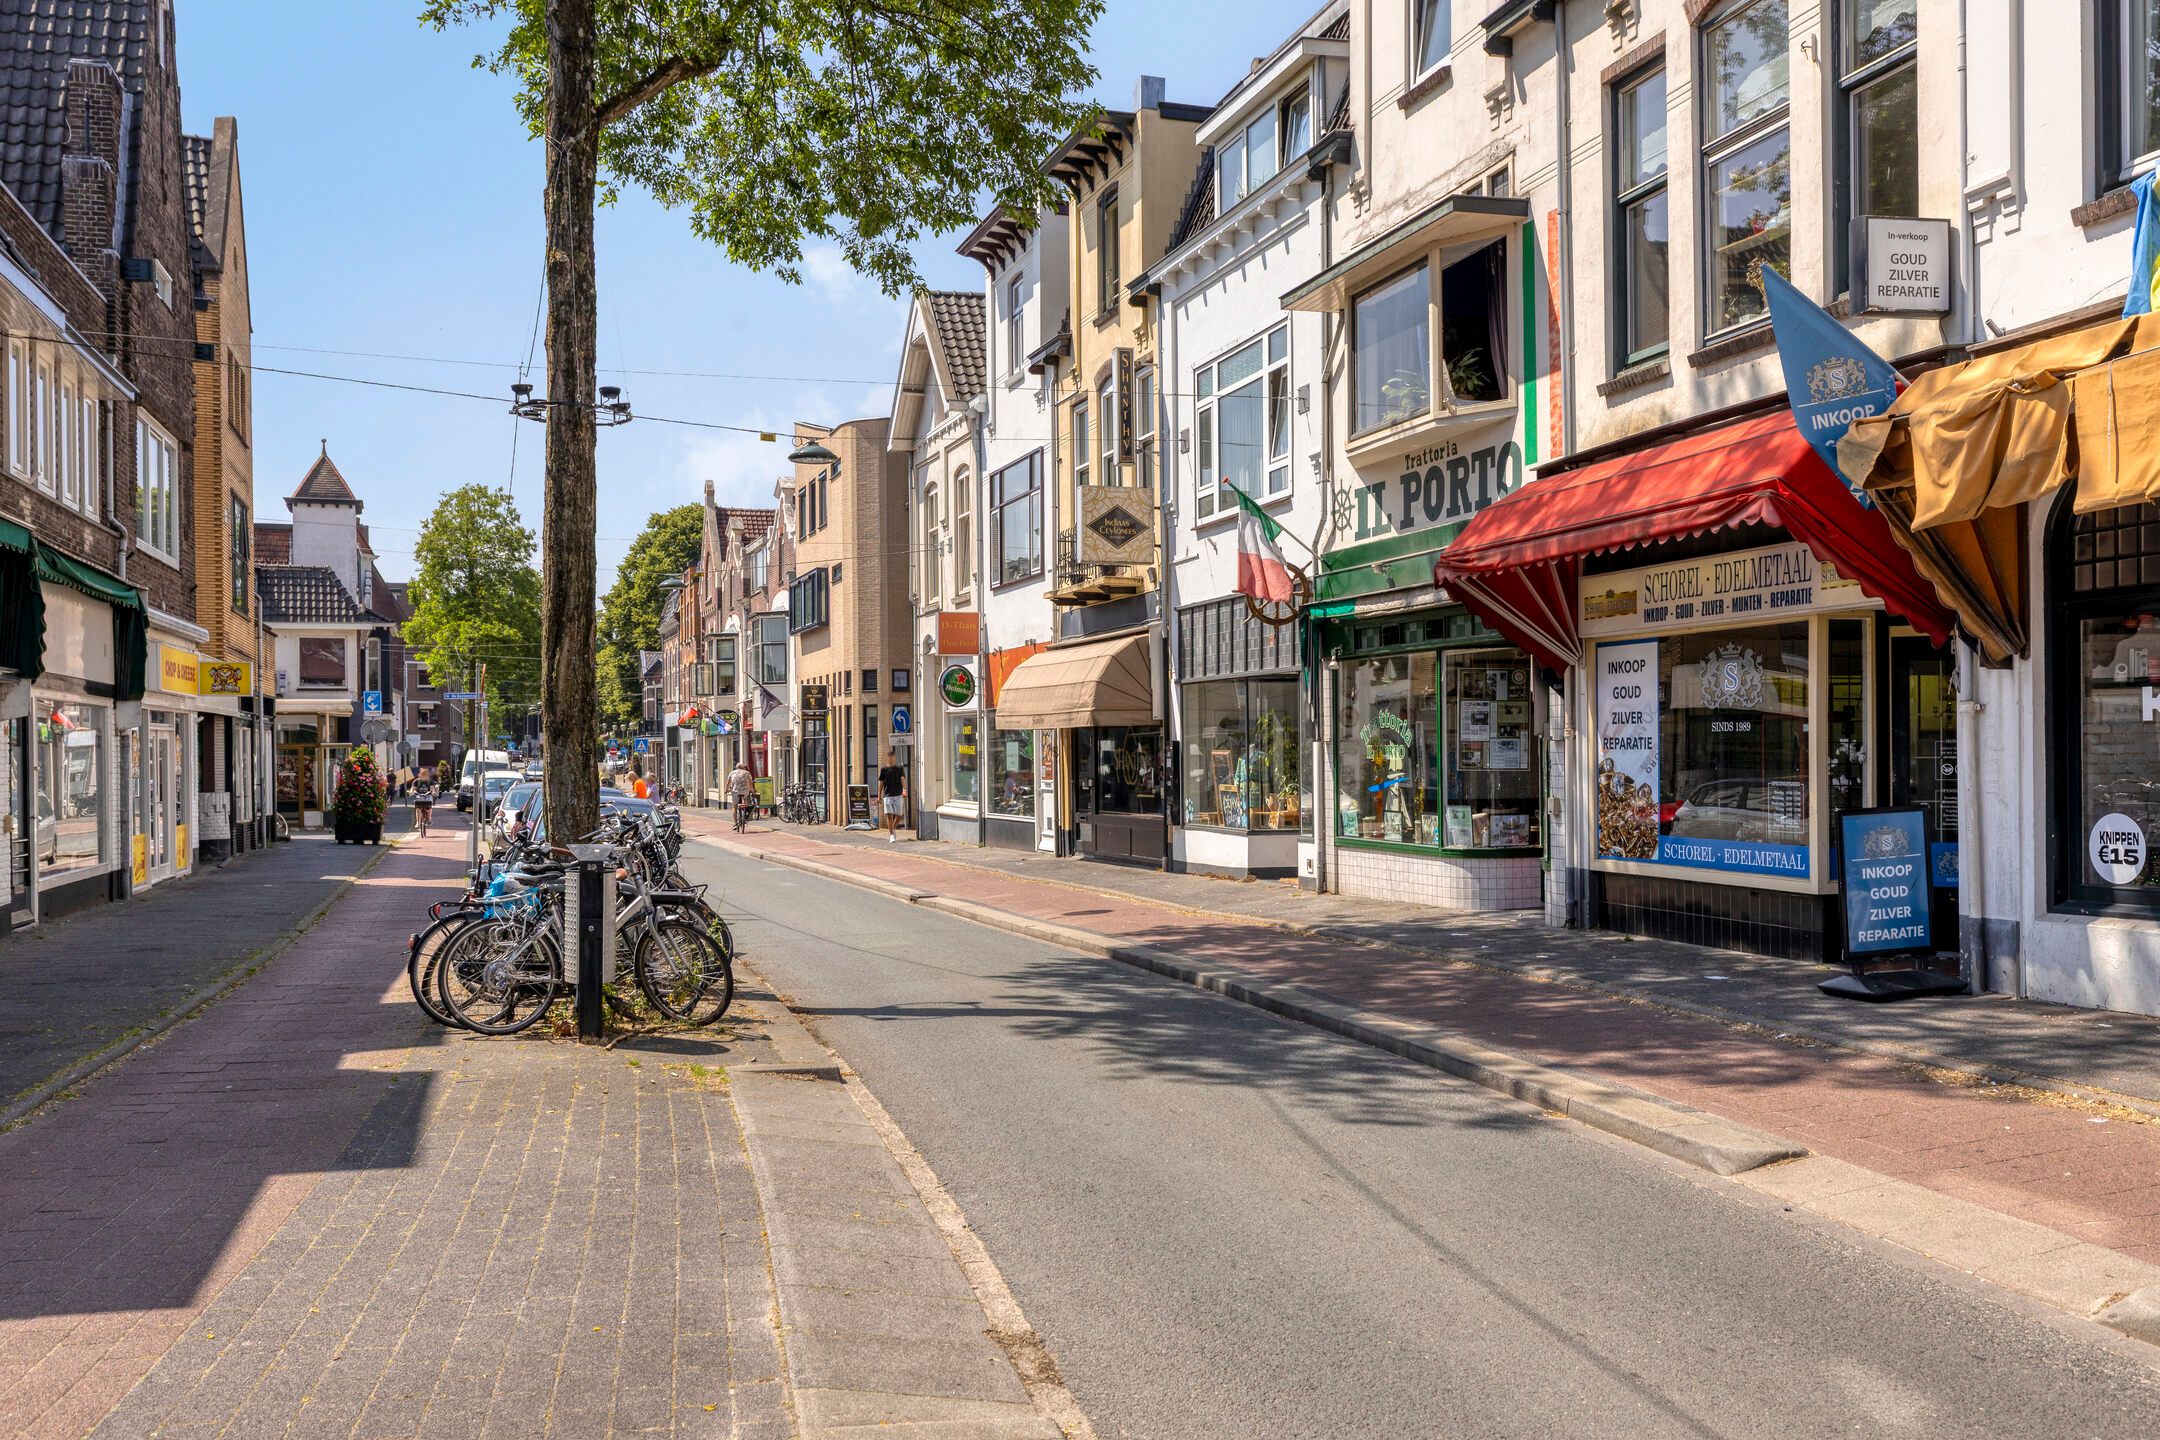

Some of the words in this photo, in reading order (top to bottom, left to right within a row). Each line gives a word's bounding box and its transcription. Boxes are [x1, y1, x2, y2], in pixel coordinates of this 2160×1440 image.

[1888, 232, 1928, 242] In-verkoop
[1890, 253, 1927, 265] GOUD
[1889, 269, 1929, 282] ZILVER
[1878, 285, 1940, 298] REPARATIE
[1121, 352, 1132, 453] SHANTHY
[1811, 404, 1876, 430] INKOOP
[1405, 441, 1458, 470] Trattoria
[1355, 480, 1392, 541] IL
[1400, 440, 1522, 530] PORTO
[1644, 566, 1704, 604] SCHOREL
[1713, 549, 1812, 595] EDELMETAAL
[1643, 606, 1669, 624] INKOOP
[1675, 603, 1694, 619] GOUD
[1701, 599, 1725, 617] ZILVER
[1731, 594, 1762, 613] MUNTEN
[1770, 587, 1813, 609] REPARATIE
[165, 660, 177, 678] CHOP
[181, 664, 196, 683] CHEESE
[1608, 659, 1646, 675] INKOOP
[1724, 662, 1739, 692] S
[1612, 685, 1641, 699] GOUD
[1611, 711, 1643, 725] ZILVER
[1711, 721, 1734, 733] SINDS
[1735, 721, 1751, 733] 1989
[1603, 737, 1653, 750] REPARATIE
[2099, 830, 2140, 846] KNIPPEN
[1664, 843, 1716, 862] SCHOREL
[1724, 848, 1806, 870] EDELMETAAL
[2098, 846, 2140, 866] €15
[1862, 864, 1913, 880] INKOOP
[1870, 885, 1909, 900] GOUD
[1869, 906, 1912, 921] ZILVER
[1858, 925, 1925, 942] REPARATIE
